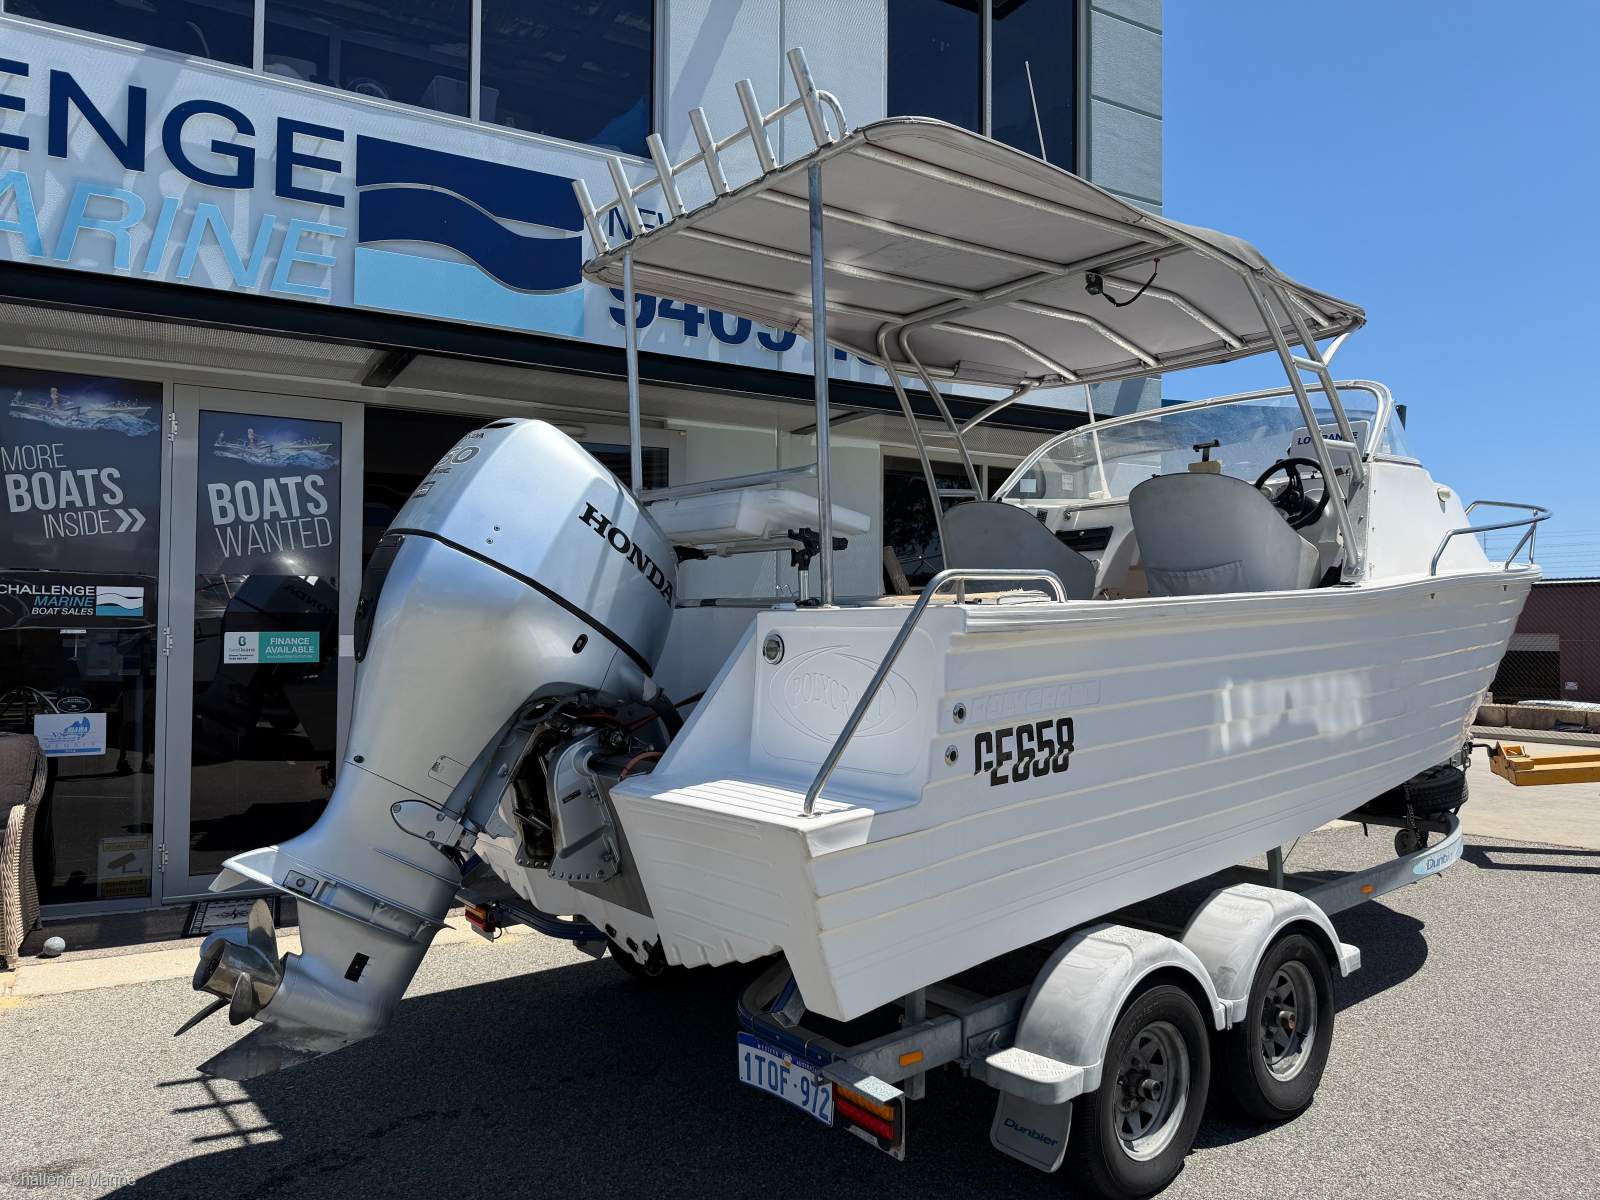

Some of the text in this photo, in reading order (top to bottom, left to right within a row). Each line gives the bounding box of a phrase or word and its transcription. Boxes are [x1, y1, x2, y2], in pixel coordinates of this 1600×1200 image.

[1297, 431, 1358, 445] LORANE
[0, 443, 67, 472] MORE
[4, 467, 124, 513] BOATS
[207, 474, 328, 526] BOATS
[42, 509, 113, 539] INSIDE
[215, 516, 333, 558] WANTED
[578, 501, 673, 608] HONDA
[0, 584, 95, 596] CHALLENGE
[33, 595, 94, 607] MARINE
[31, 607, 94, 616] BOAT SALES
[265, 646, 314, 654] AVAILABLE
[270, 637, 310, 645] FINANCE
[1004, 1117, 1058, 1147] Dunbier
